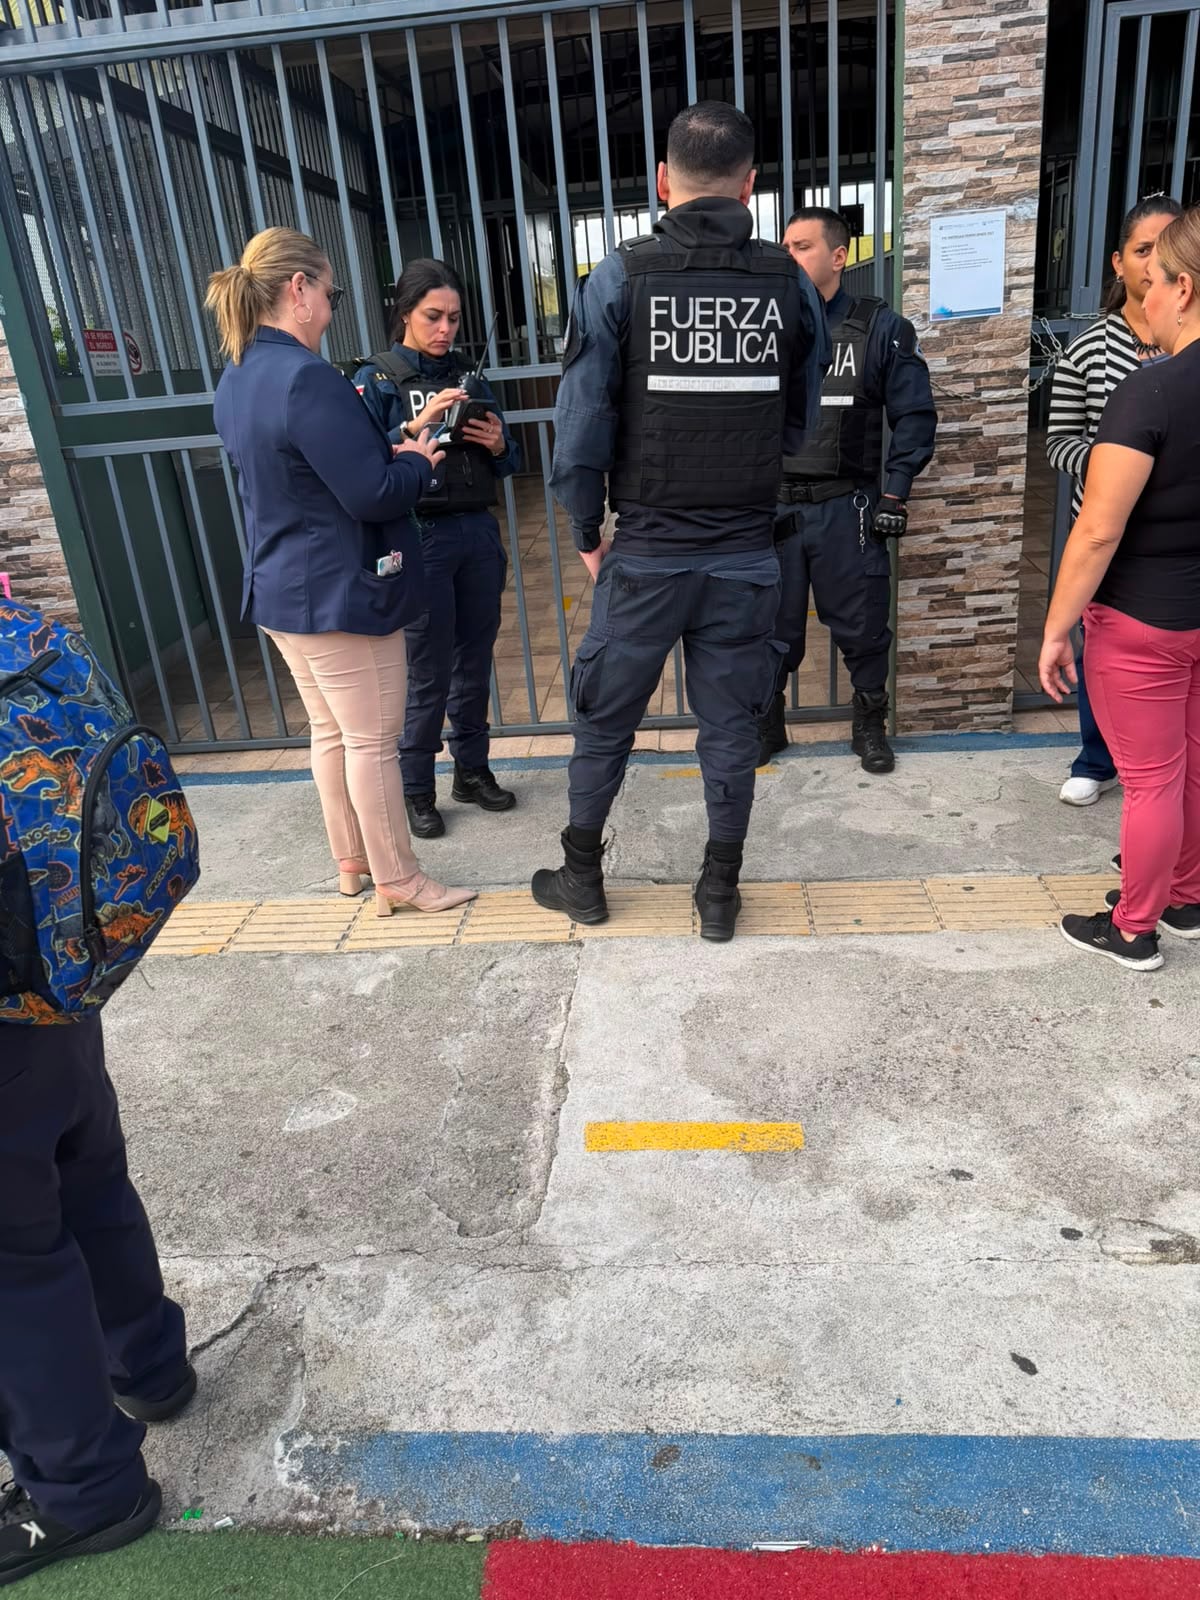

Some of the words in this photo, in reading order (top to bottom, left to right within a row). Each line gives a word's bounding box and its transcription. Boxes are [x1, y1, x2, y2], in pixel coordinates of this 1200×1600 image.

[650, 296, 784, 330] FUERZA
[650, 330, 779, 363] PUBLICA
[827, 342, 856, 377] IA
